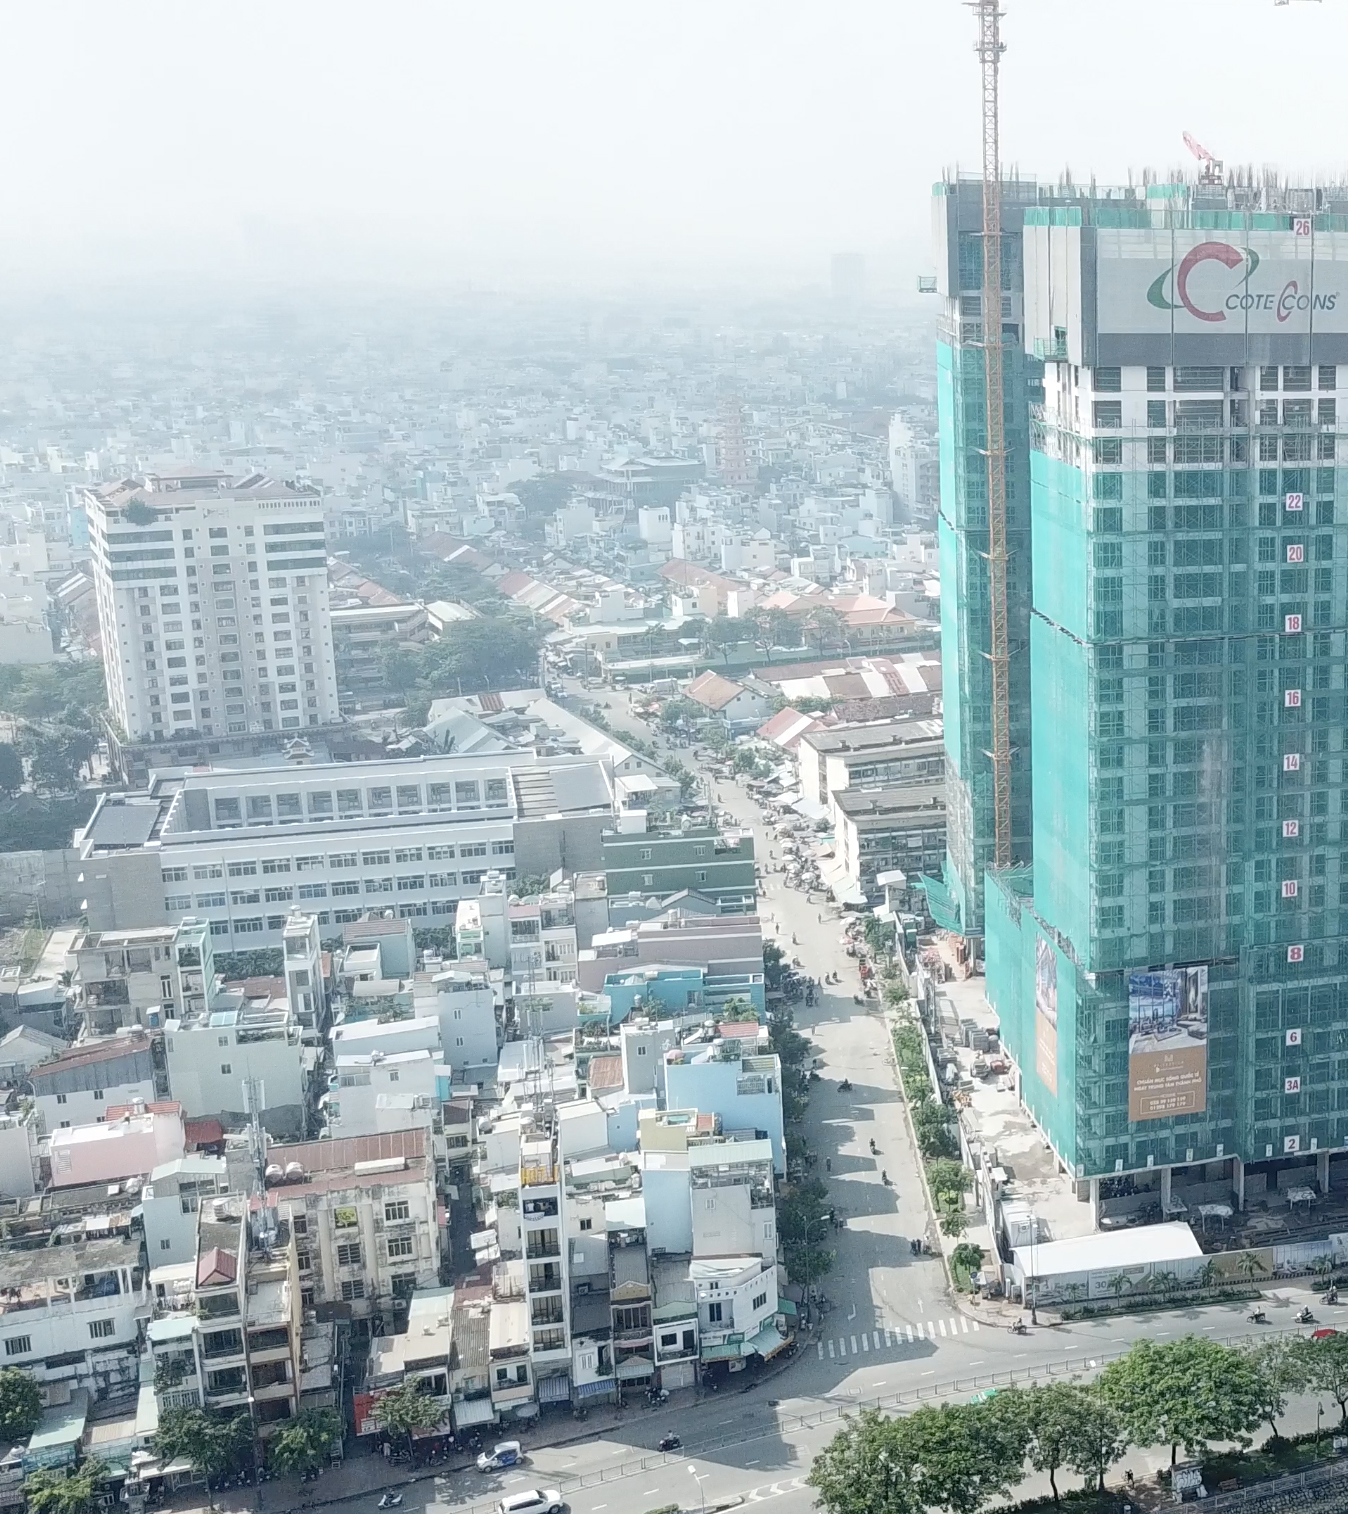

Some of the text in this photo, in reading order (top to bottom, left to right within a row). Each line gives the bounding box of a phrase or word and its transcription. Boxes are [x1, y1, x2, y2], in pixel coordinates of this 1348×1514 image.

[1296, 220, 1310, 236] 26
[1288, 495, 1301, 509] 22
[1289, 547, 1302, 561] 20
[1288, 616, 1299, 630] 18
[1287, 691, 1299, 705] 16
[1286, 755, 1298, 769] 14
[1285, 821, 1297, 835] 12
[1284, 882, 1296, 896] 10
[1290, 947, 1302, 960] 8
[1290, 1031, 1297, 1042] 6
[1286, 1079, 1299, 1091] 3A
[1288, 1138, 1296, 1149] 2
